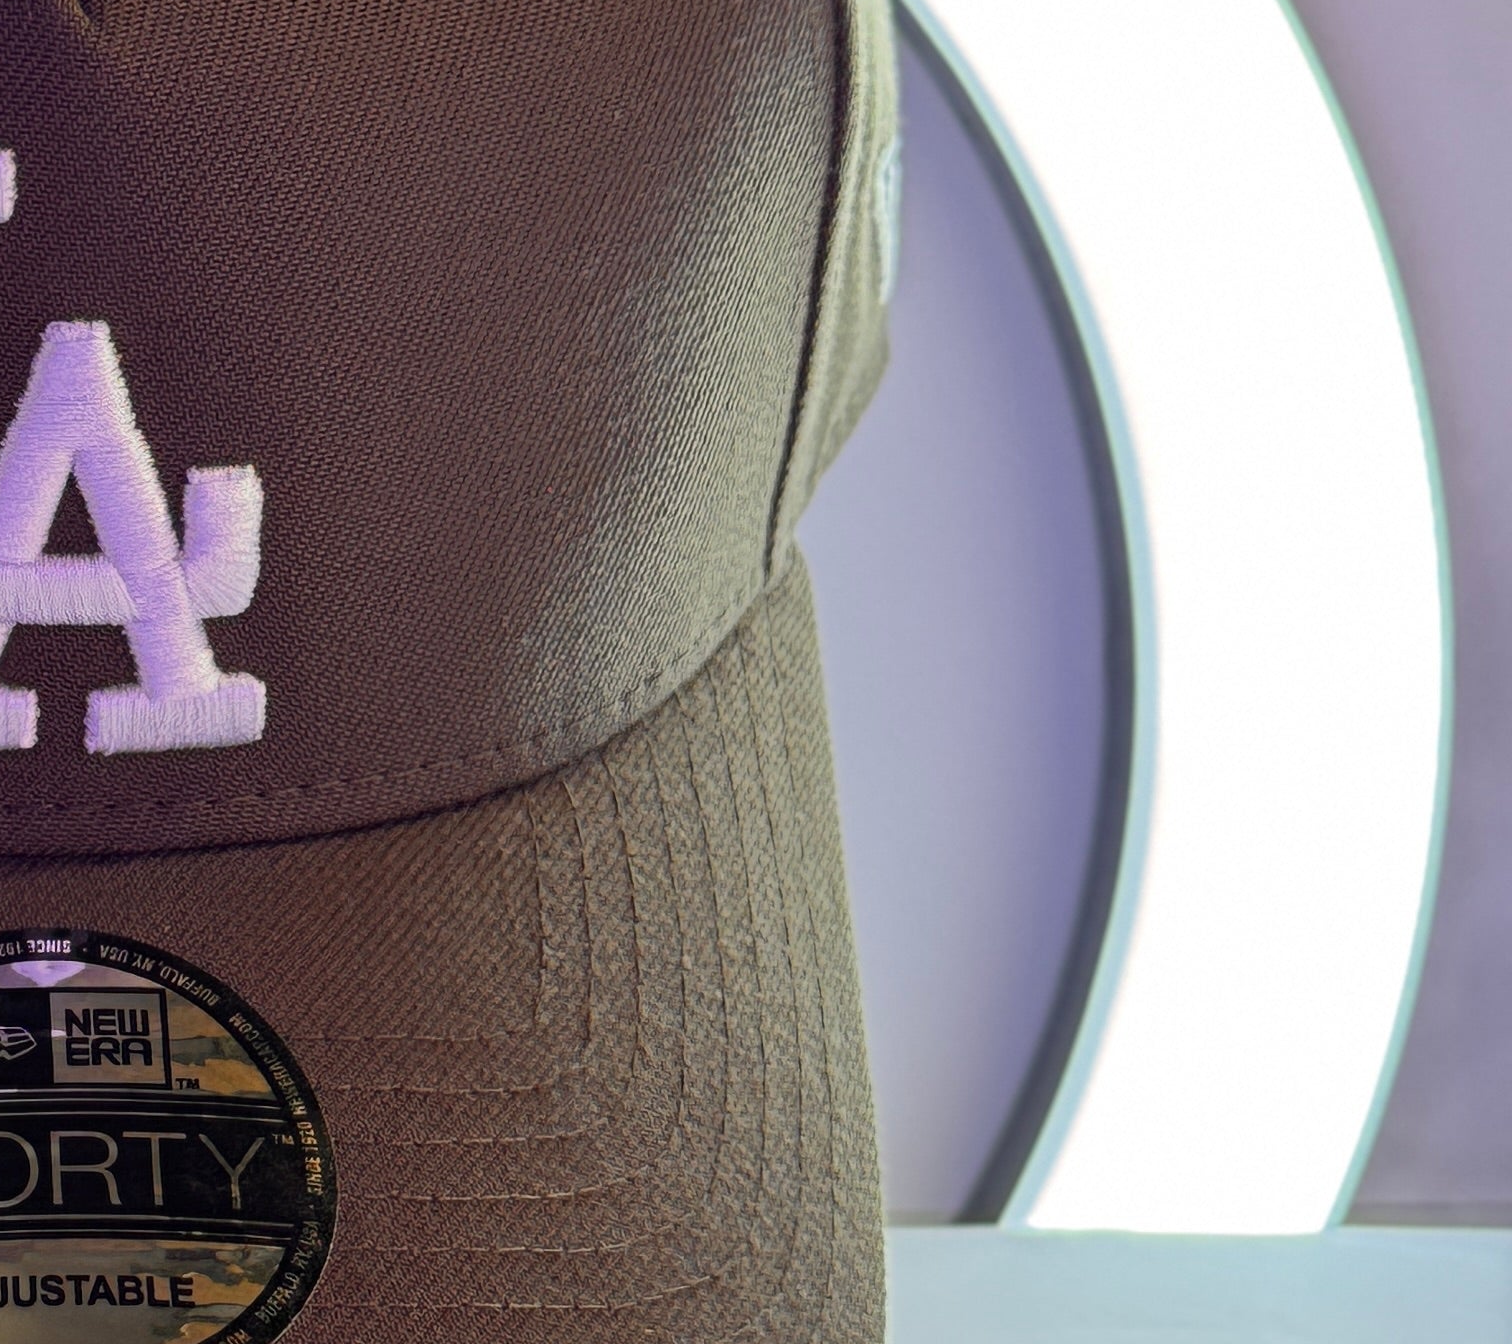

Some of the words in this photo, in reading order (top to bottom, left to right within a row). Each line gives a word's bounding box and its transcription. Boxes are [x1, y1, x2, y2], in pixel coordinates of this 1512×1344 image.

[27, 939, 72, 954] SINCE
[100, 944, 129, 963] USA
[64, 1008, 150, 1036] NEW
[65, 1038, 153, 1067] ERA
